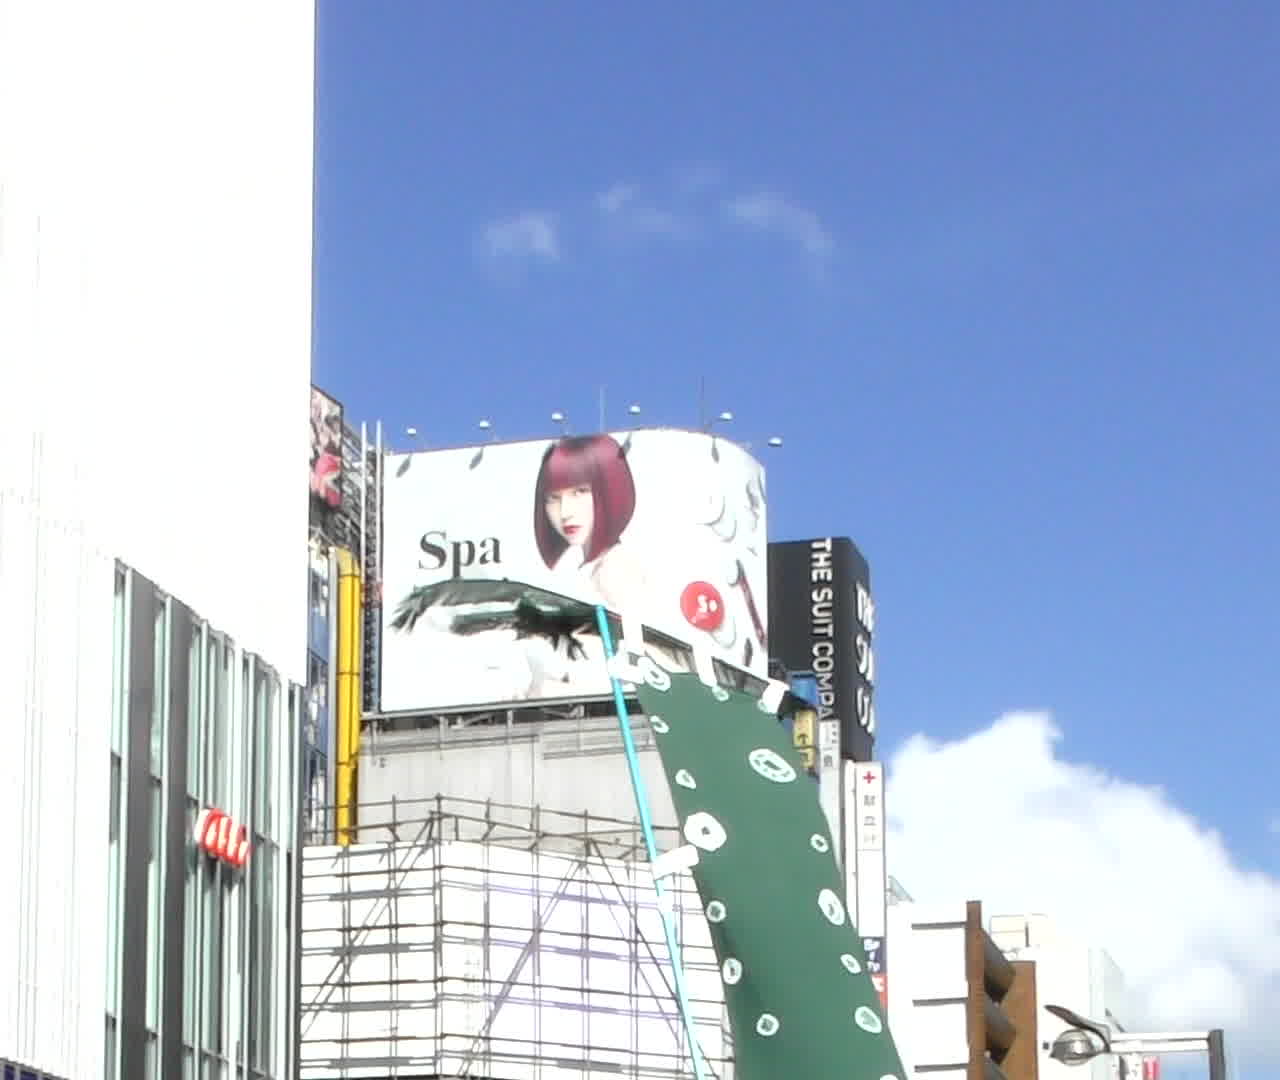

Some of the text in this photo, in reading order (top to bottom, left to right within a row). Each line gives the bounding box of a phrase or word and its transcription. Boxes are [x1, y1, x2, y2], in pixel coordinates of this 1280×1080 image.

[418, 530, 503, 578] Spa
[811, 536, 833, 582] THE
[811, 587, 833, 638] SUIT
[814, 642, 835, 721] COMPA
